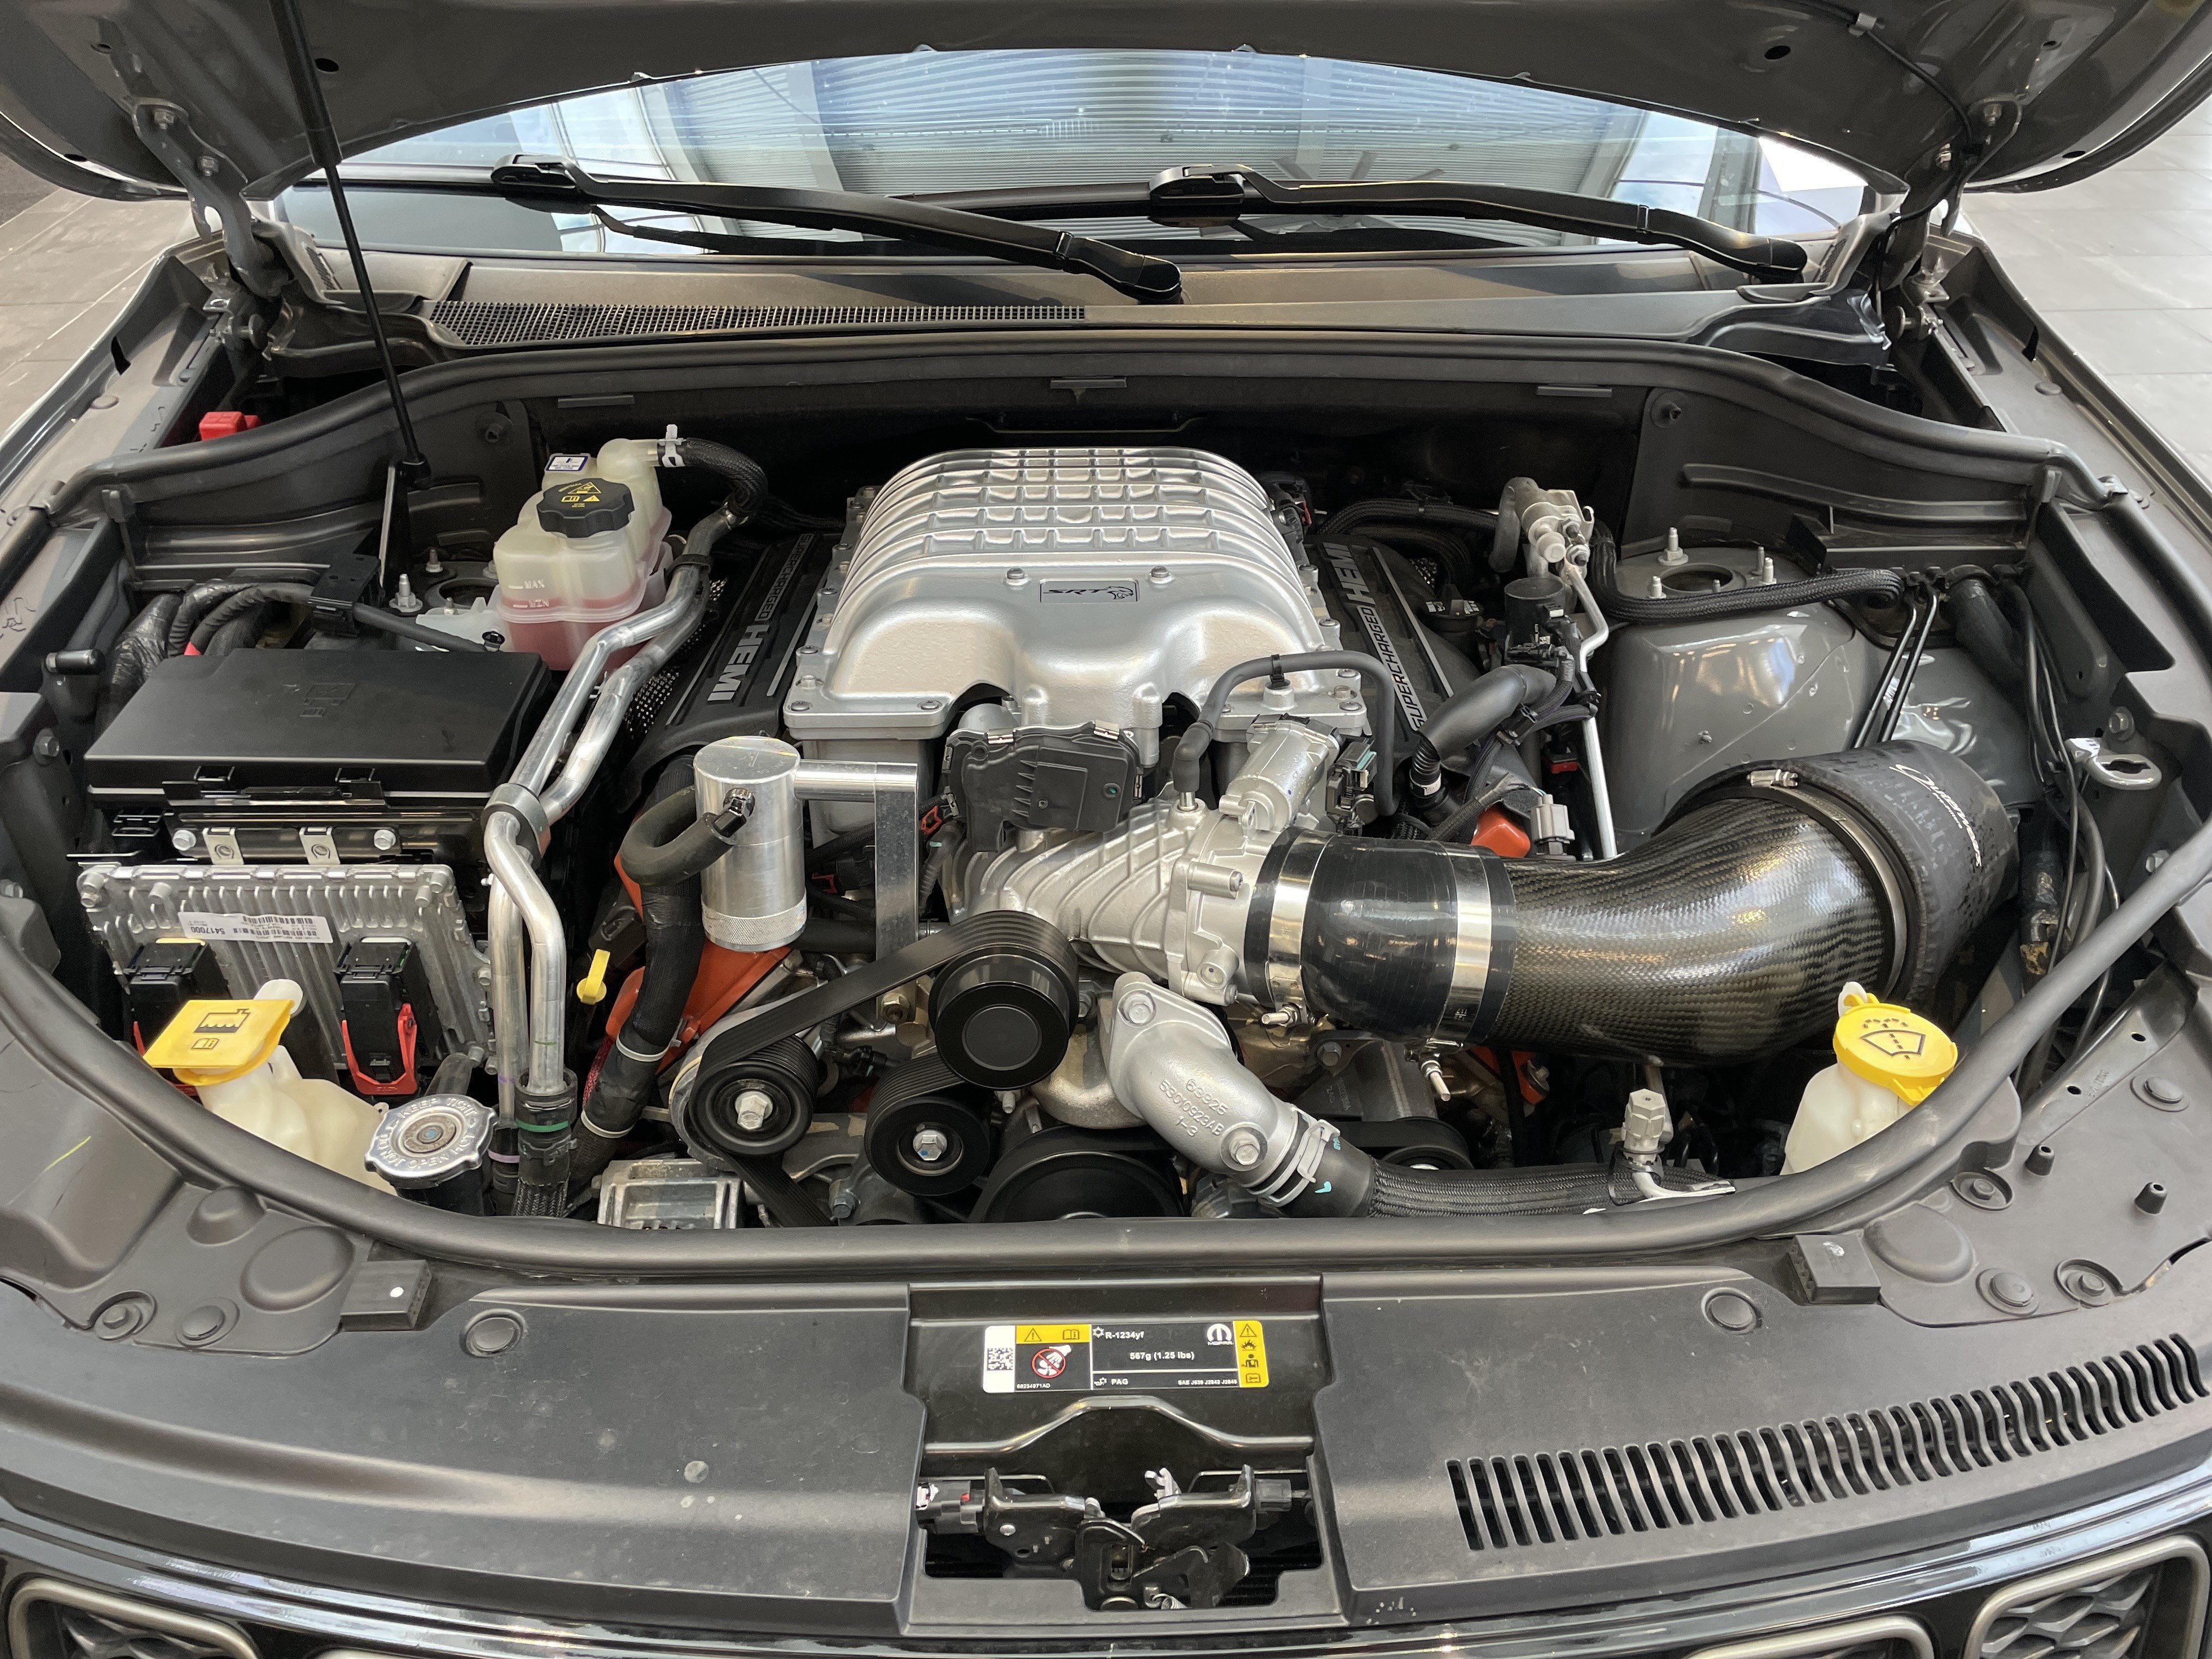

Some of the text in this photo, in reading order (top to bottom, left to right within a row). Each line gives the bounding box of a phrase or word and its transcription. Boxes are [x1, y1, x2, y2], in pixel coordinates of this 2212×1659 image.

[1323, 542, 1376, 605] HEMI
[524, 580, 545, 589] MAX
[528, 599, 549, 608] MIN
[708, 624, 770, 701] HEMI
[1361, 606, 1426, 729] SUPERCHARGED
[191, 926, 225, 935] 5417000
[408, 1154, 449, 1170] OPEN
[1105, 1331, 1144, 1340] R-1234yf
[1130, 1351, 1195, 1361] 567g (1.25 lbs)
